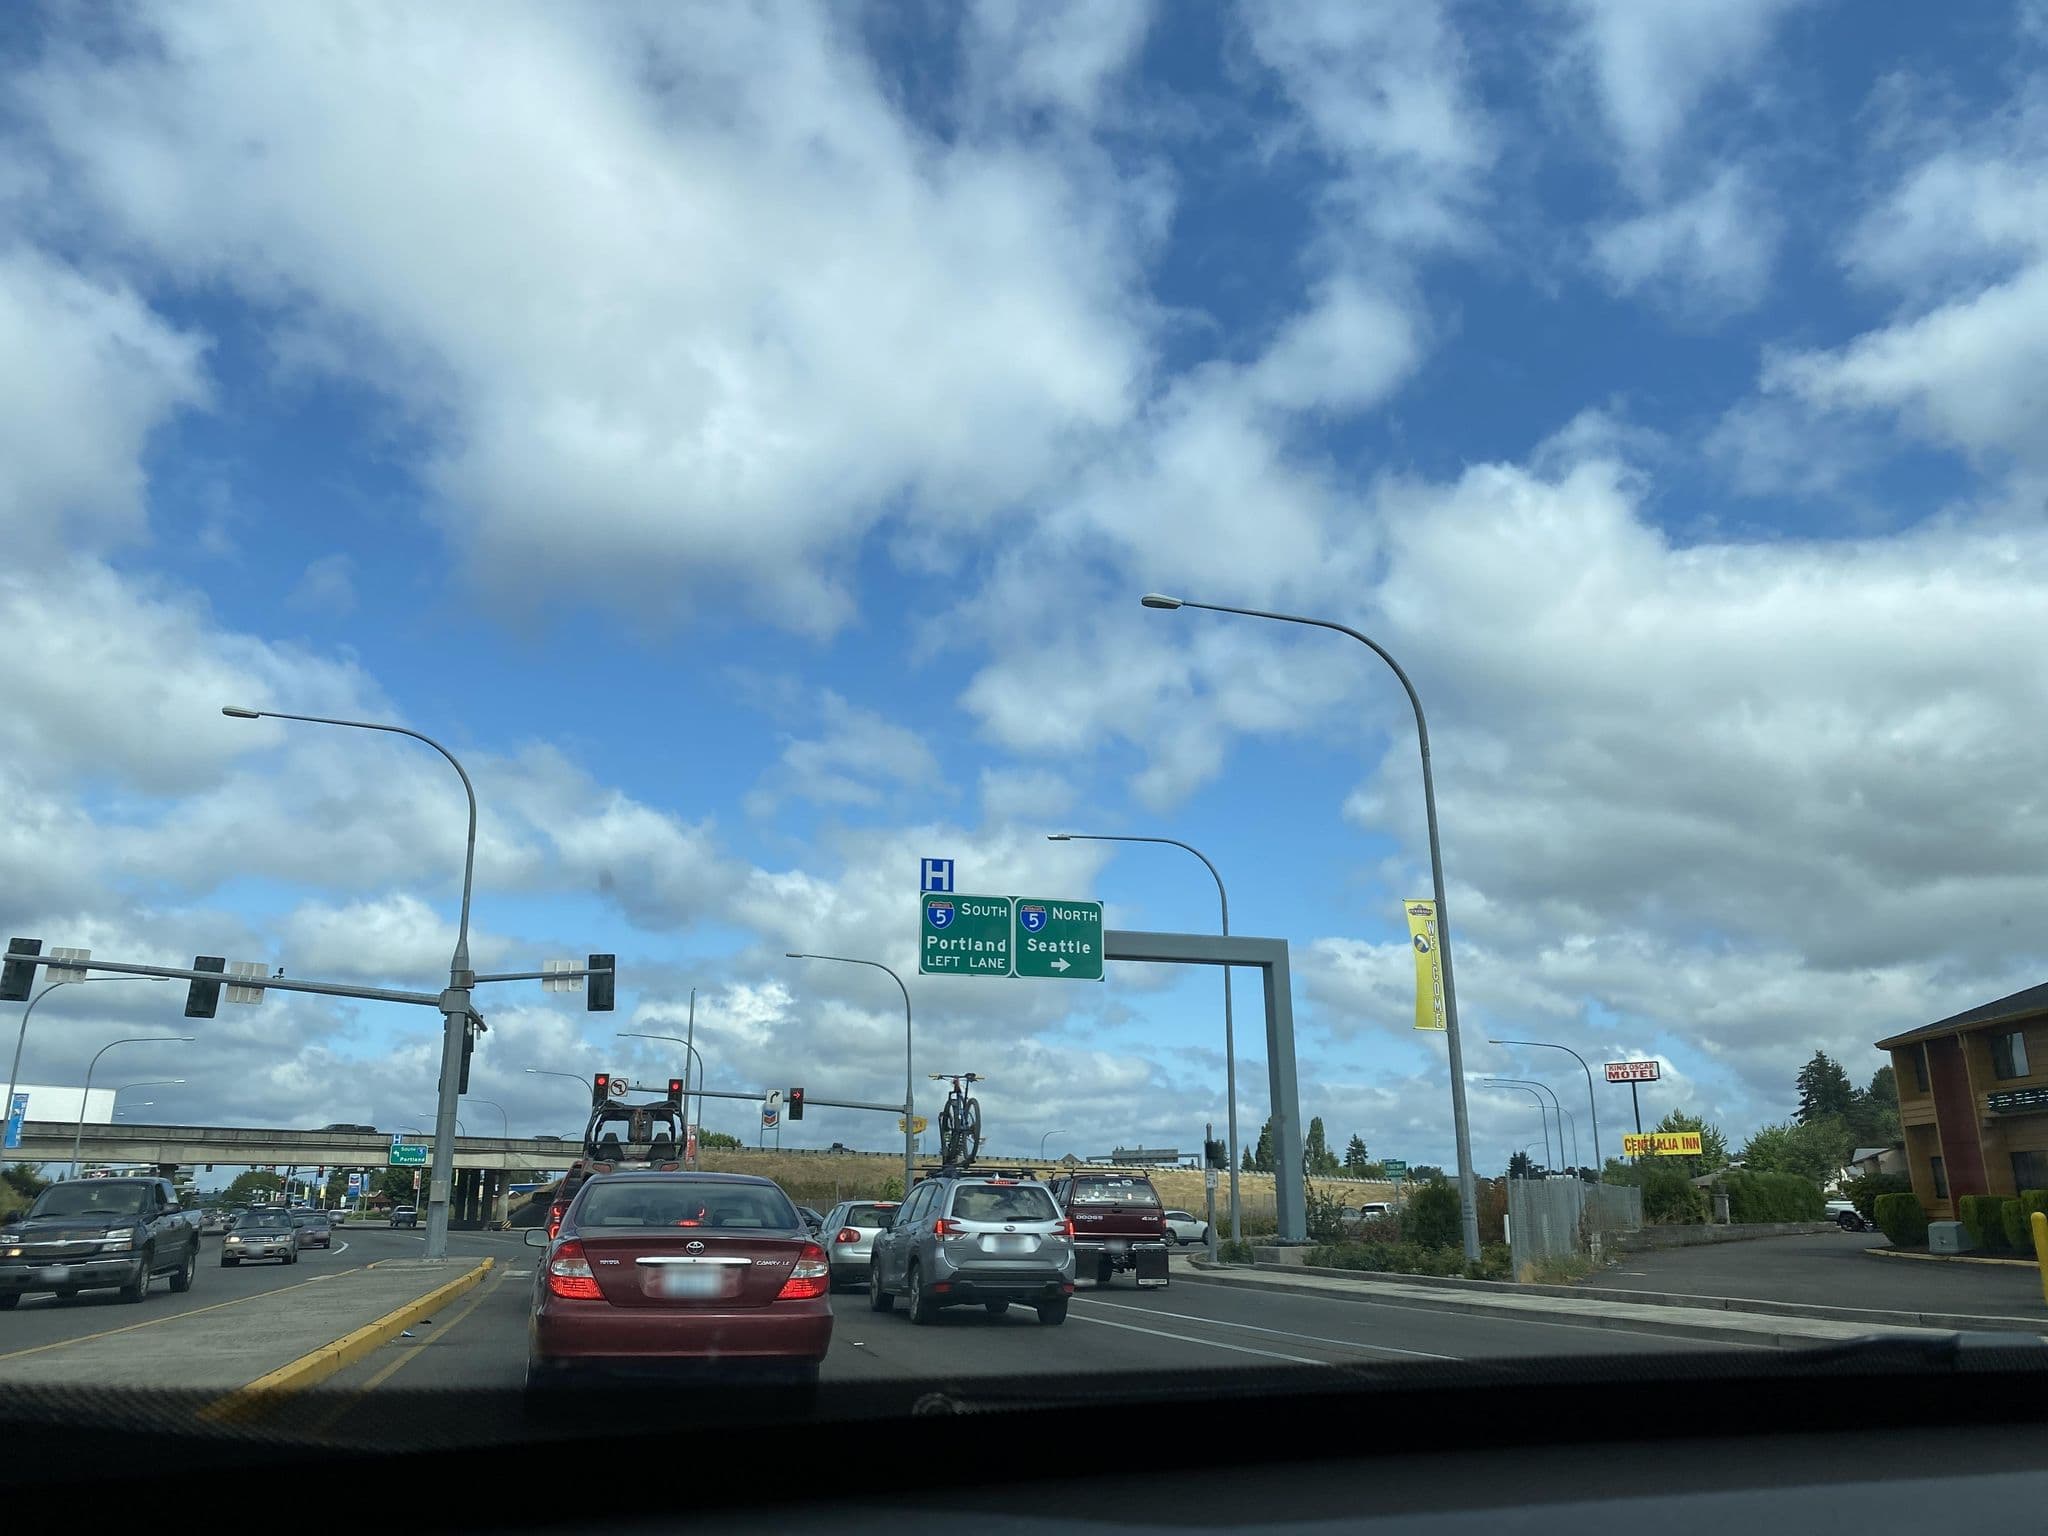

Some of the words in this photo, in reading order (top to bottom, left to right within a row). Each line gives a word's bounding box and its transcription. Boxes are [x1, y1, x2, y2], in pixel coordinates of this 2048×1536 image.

[925, 860, 950, 890] H
[935, 909, 947, 925] 5
[961, 902, 1008, 918] SOUTH
[1029, 913, 1039, 928] 5
[1052, 907, 1098, 922] NORTH
[927, 935, 1006, 952] Portland
[1026, 938, 1092, 954] Seattle
[927, 956, 960, 967] LEFT
[969, 957, 1006, 969] LANE
[1425, 919, 1442, 1028] WELCOME
[1608, 1070, 1657, 1079] MOTEL
[1681, 1136, 1700, 1150] INN
